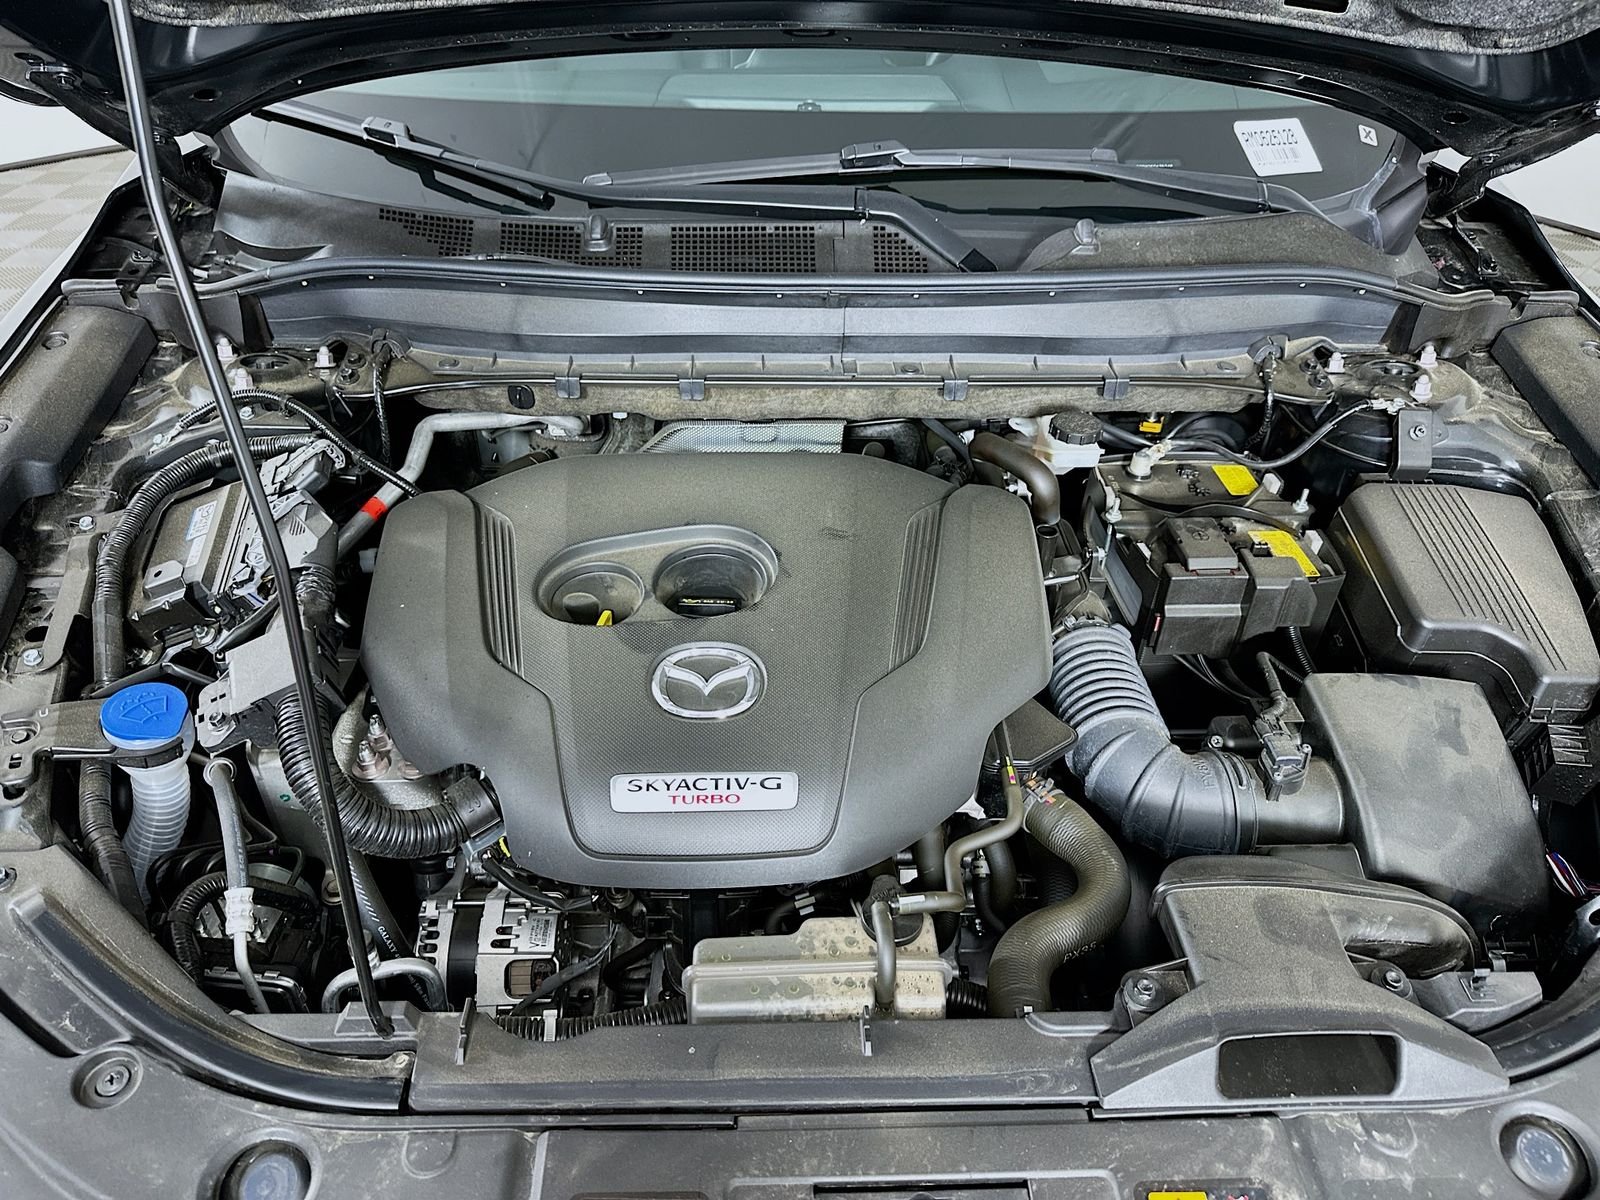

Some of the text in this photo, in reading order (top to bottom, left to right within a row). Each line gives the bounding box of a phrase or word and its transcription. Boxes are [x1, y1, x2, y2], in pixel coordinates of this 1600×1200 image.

[627, 776, 783, 793] SKYACTIV-G
[668, 793, 741, 805] TURBO
[377, 925, 399, 953] GALAXY
